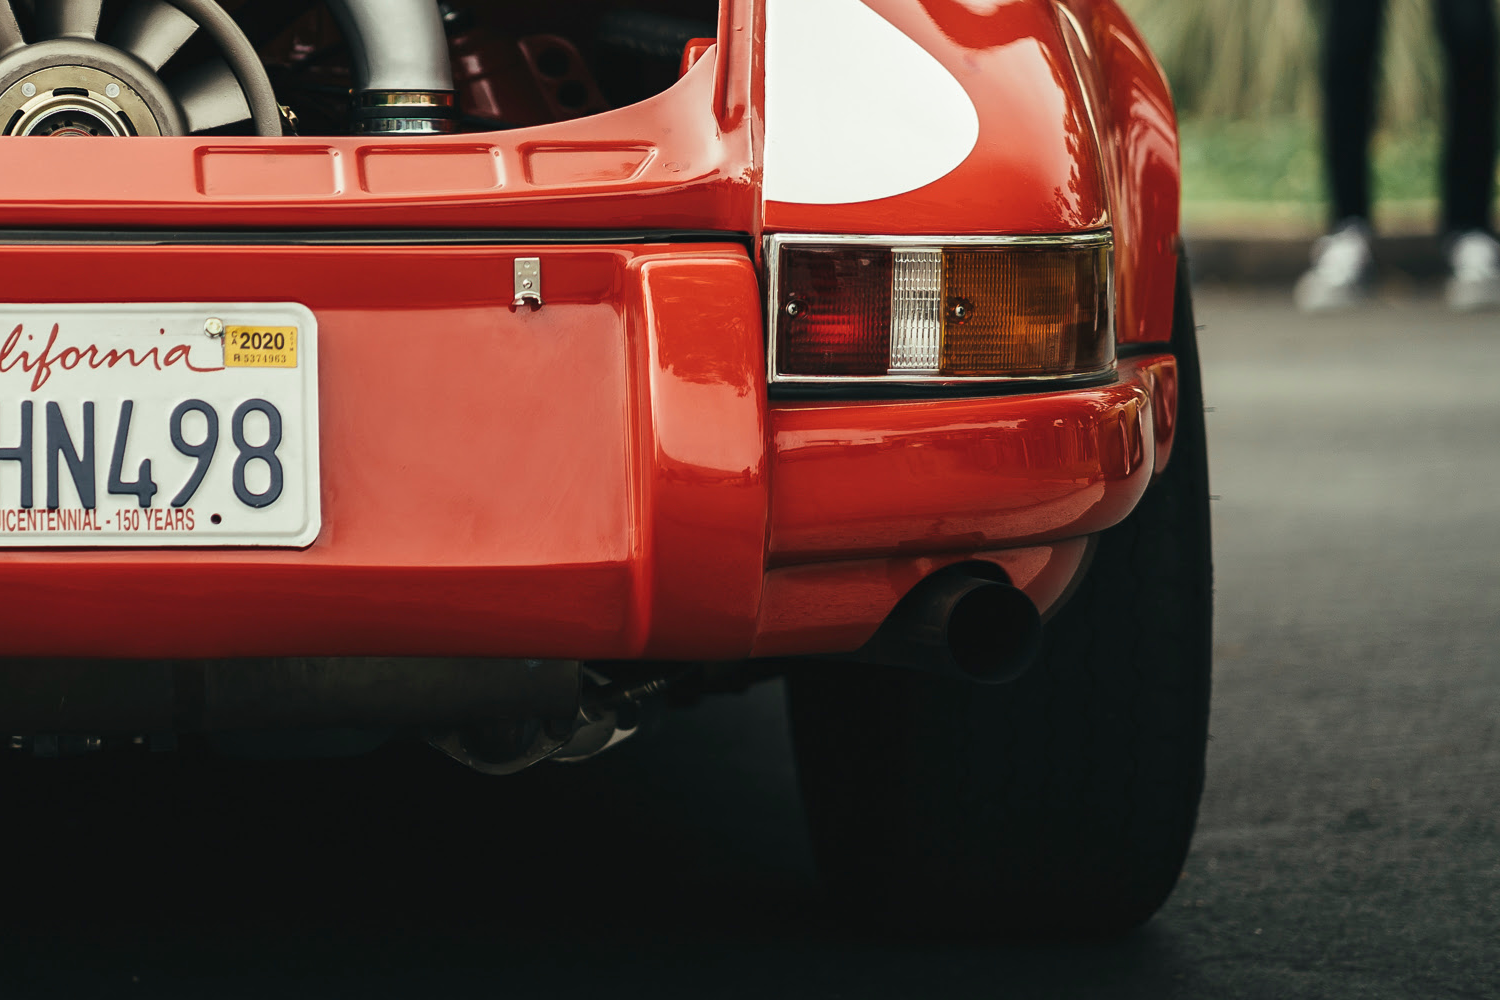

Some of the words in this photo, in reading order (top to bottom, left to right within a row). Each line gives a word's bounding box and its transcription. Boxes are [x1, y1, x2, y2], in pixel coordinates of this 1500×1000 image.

[240, 332, 284, 350] 2020
[115, 508, 140, 531] 150
[144, 507, 195, 531] YEARS
